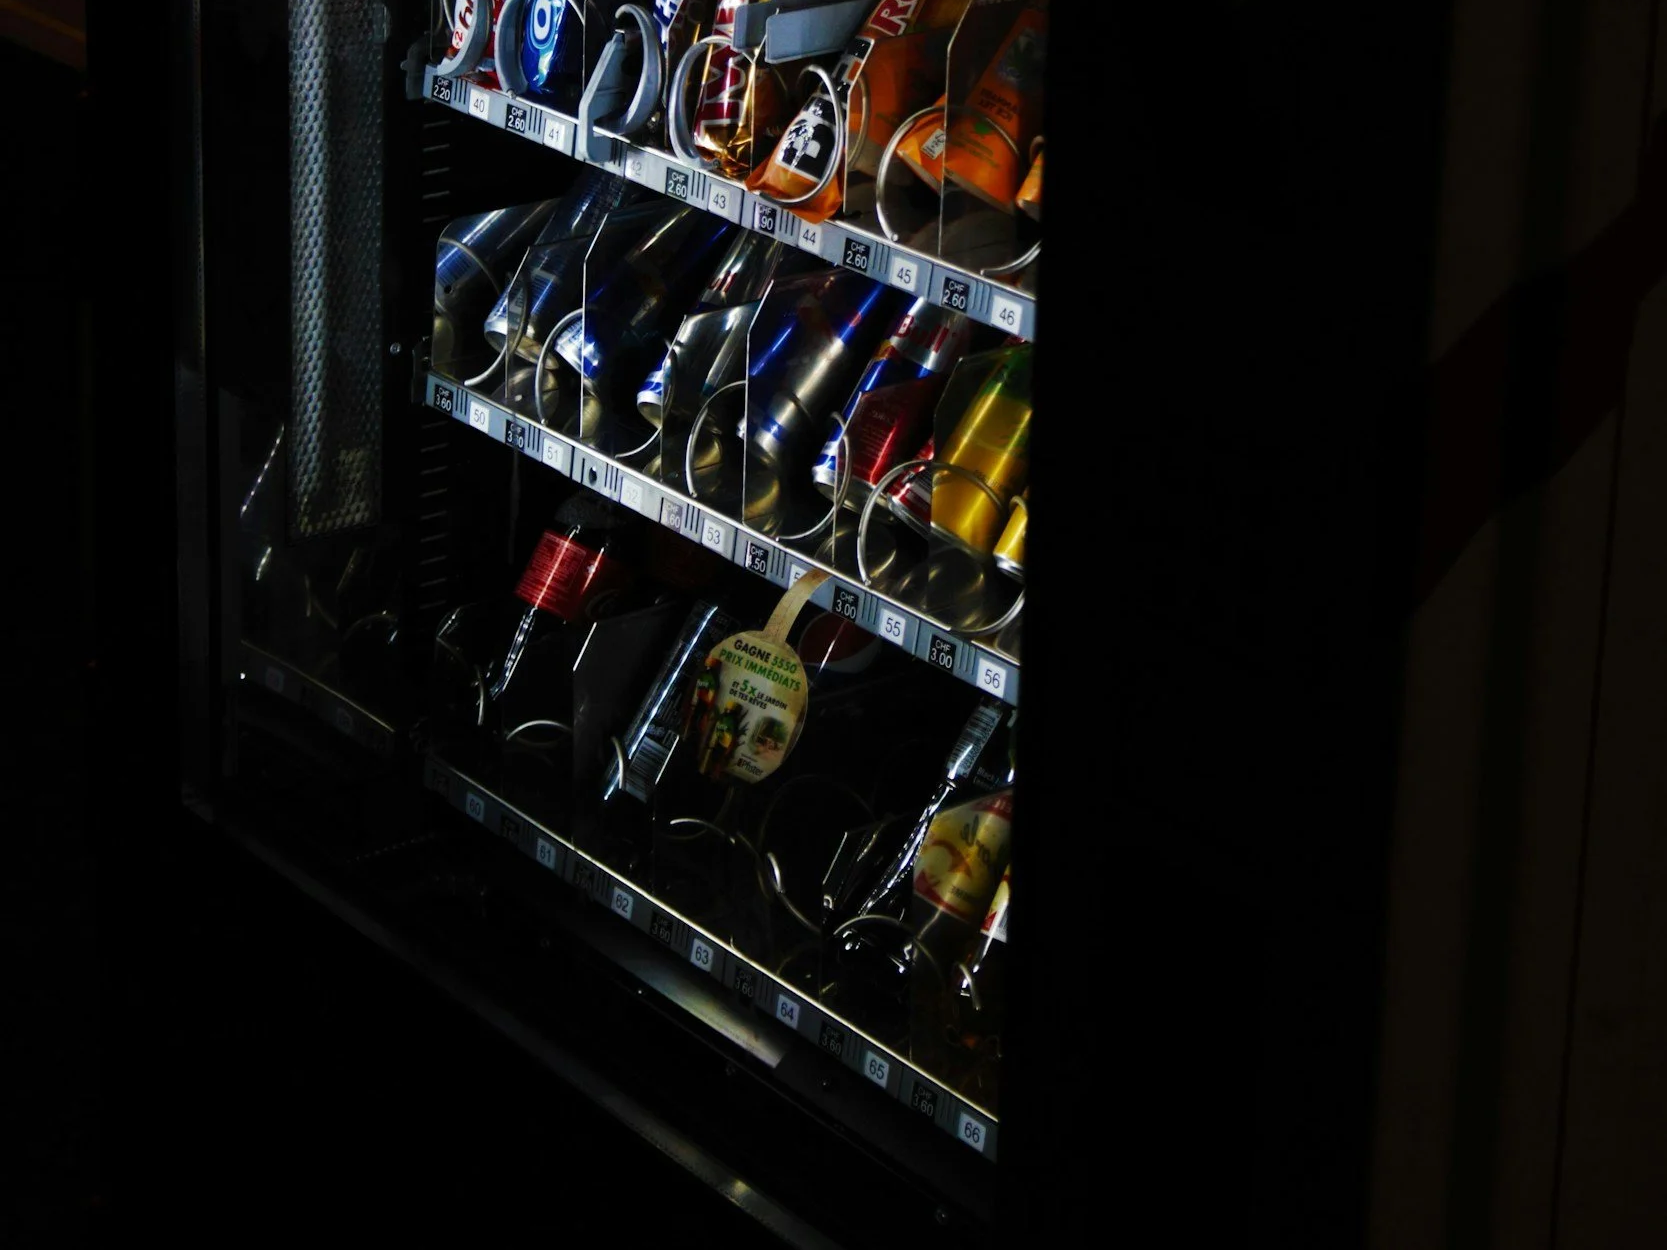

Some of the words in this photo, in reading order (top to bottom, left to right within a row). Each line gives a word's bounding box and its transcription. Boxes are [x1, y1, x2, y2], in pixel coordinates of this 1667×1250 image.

[437, 76, 450, 87] CHF
[433, 86, 451, 101] 2.20
[473, 98, 485, 113] 40
[511, 106, 524, 117] CHF
[507, 115, 525, 131] 2.60
[548, 125, 560, 141] 41
[671, 171, 686, 183] CHF
[667, 182, 687, 198] 2.60
[712, 192, 727, 210] 43
[757, 214, 774, 231] .90
[802, 228, 816, 246] 44
[850, 241, 866, 253] CHF
[845, 250, 867, 269] 2.60
[897, 268, 912, 285] 45
[948, 280, 965, 293] CHF
[942, 292, 966, 310] 2.60
[999, 308, 1015, 326] 46
[435, 394, 452, 412] 3.60
[473, 408, 486, 425] 50
[707, 525, 721, 545] 53
[750, 545, 764, 557] CHF
[840, 591, 855, 603] CHF
[835, 600, 857, 620] 3.00
[884, 617, 901, 637] 55
[734, 639, 771, 664] GAGNE
[935, 639, 951, 651] CHF
[930, 648, 953, 669] 3.00
[719, 648, 742, 667] PRIX
[744, 659, 802, 692] IMMÉDIATS
[983, 669, 1001, 689] 56
[469, 799, 481, 816] 60
[616, 894, 629, 913] 62
[651, 922, 670, 943] 3.60
[695, 945, 709, 965] 63
[735, 978, 753, 998] 3.60
[780, 1001, 794, 1021] 64
[821, 1035, 842, 1055] 3.60
[869, 1058, 885, 1080] 65
[913, 1094, 934, 1117] 3.60
[964, 1121, 981, 1144] 66
